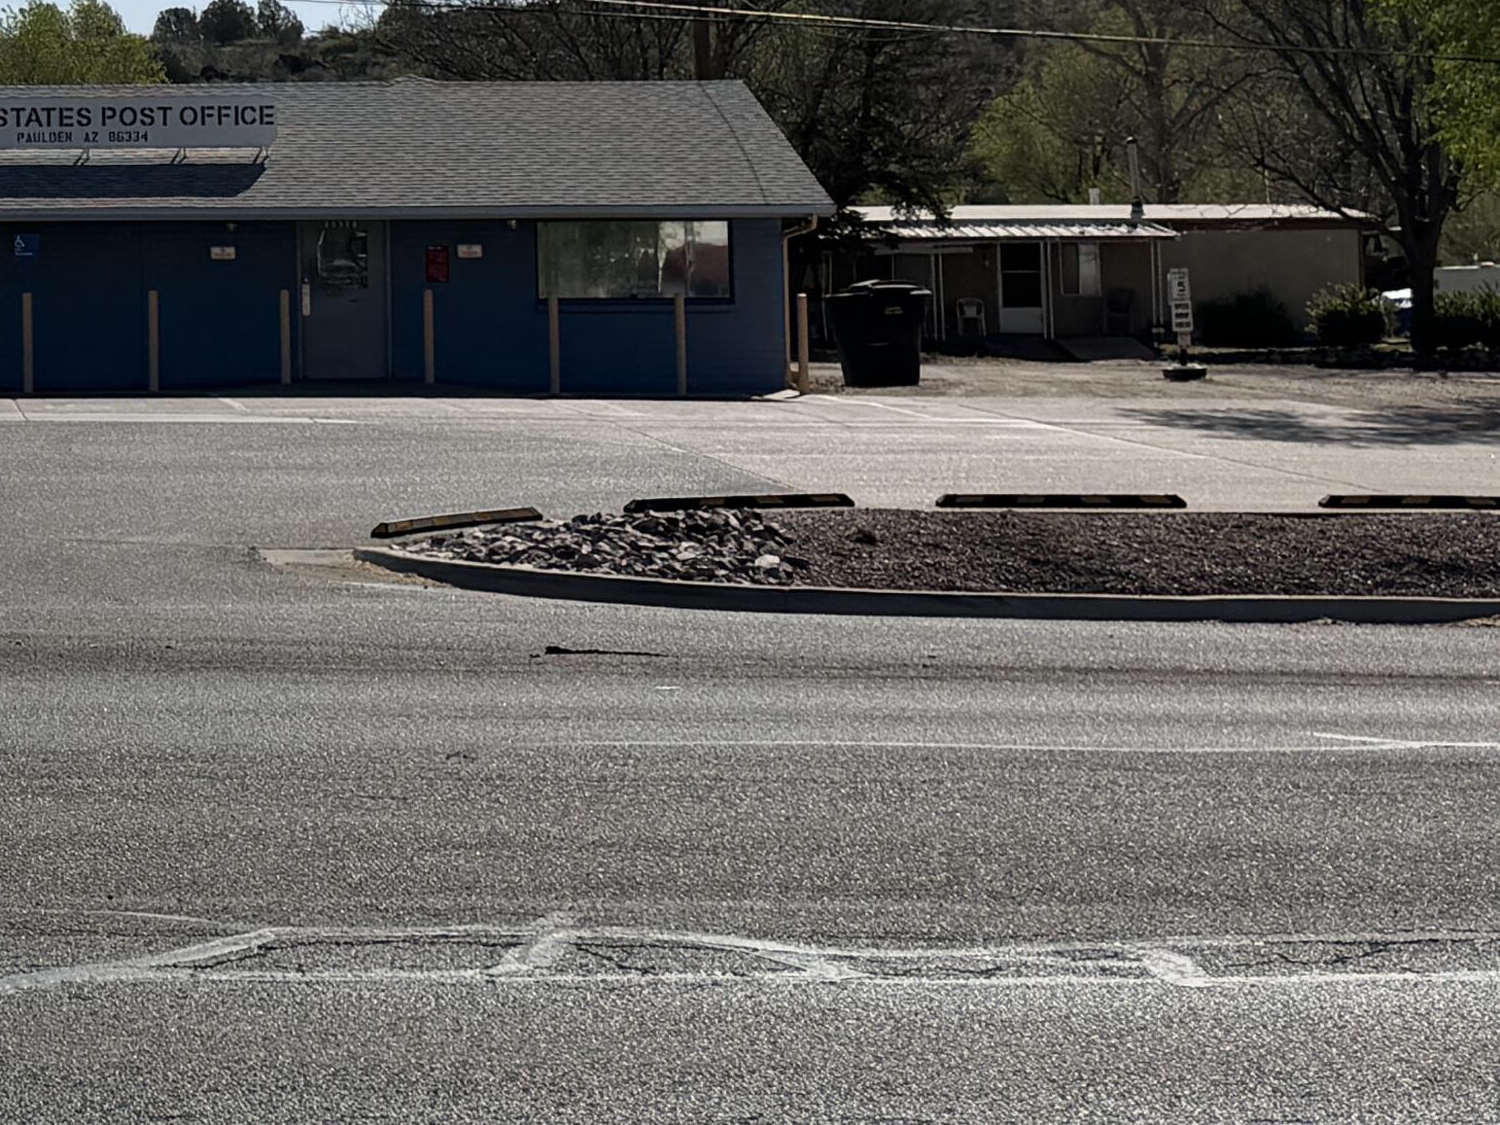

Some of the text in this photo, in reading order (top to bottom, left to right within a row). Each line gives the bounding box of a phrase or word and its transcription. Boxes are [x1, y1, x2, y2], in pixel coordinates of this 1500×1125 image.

[101, 106, 172, 127] POST
[179, 105, 275, 126] OFFICE
[17, 131, 149, 143] PAULDEN AZ 86334
